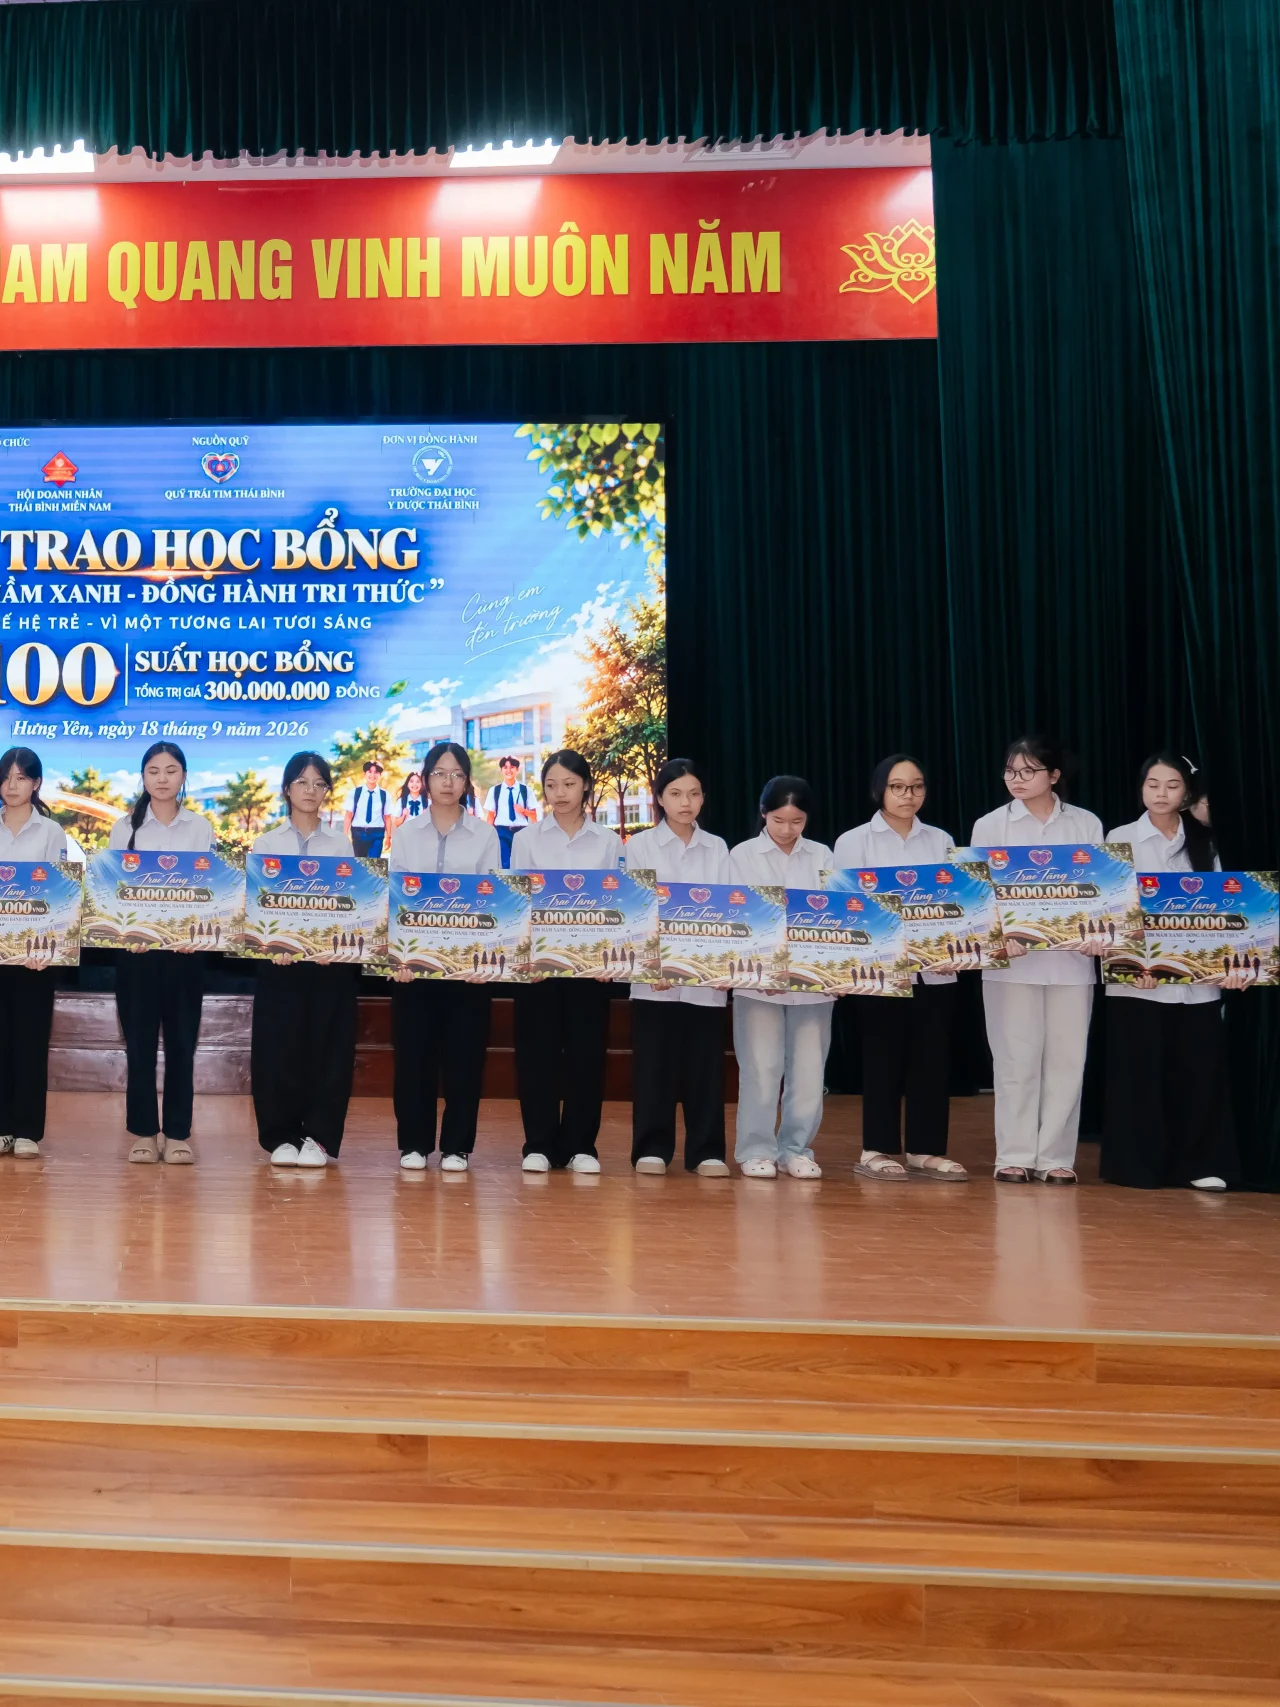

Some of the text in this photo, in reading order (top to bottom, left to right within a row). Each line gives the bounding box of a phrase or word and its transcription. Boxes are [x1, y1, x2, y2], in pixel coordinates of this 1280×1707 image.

[107, 237, 293, 310] QUANG
[311, 236, 439, 299] VINH
[461, 221, 629, 298] MUÔN
[650, 218, 781, 295] NĂM
[3, 436, 30, 447] CHỨC
[192, 434, 249, 447] NGUỒN QUỸ
[383, 433, 478, 446] ĐƠN VỊ ĐỒNG HÀNH
[17, 488, 103, 500] HỘI DOANH NHÂN
[165, 487, 285, 500] QUỸ TRÁI TIM THÁI BÌNH
[389, 486, 477, 499] TRƯỜNG ĐẠI HỌC
[9, 499, 111, 512] THÁI BÌNH MIỀN NAM
[388, 499, 480, 512] Y DƯỢC THÁI BÌNH
[0, 529, 142, 571] TRAO
[151, 528, 261, 580] HỌC
[272, 507, 421, 571] BỔNG
[49, 583, 121, 604] XANH
[141, 576, 218, 604] ĐỒNG
[223, 578, 296, 603] HÀNH
[302, 583, 346, 603] TRI
[19, 613, 41, 632] HỆ
[48, 612, 80, 629] TRẺ
[100, 614, 117, 629] VÌ
[125, 613, 162, 632] MỘT
[169, 615, 231, 629] TƯƠNG
[238, 616, 265, 629] LAI
[273, 615, 316, 629] TƯƠI
[323, 613, 372, 629] SÁNG
[134, 639, 355, 678] SUẤT HỌC BỔNG
[134, 681, 380, 701] TỔNG TRỊ GIÁ 300.000.000 ĐỒNG
[13, 719, 309, 742] Hưng Yên, ngày 18 tháng 9 năm 2026
[124, 888, 196, 902] 3.000.000
[996, 885, 1078, 900] 3.000.000
[264, 894, 338, 910] 3.000.000
[405, 912, 478, 928] 3.000.000
[531, 911, 606, 925] 3.000.000
[1144, 916, 1226, 930] 3.000.000
[786, 928, 852, 944] .000.000
